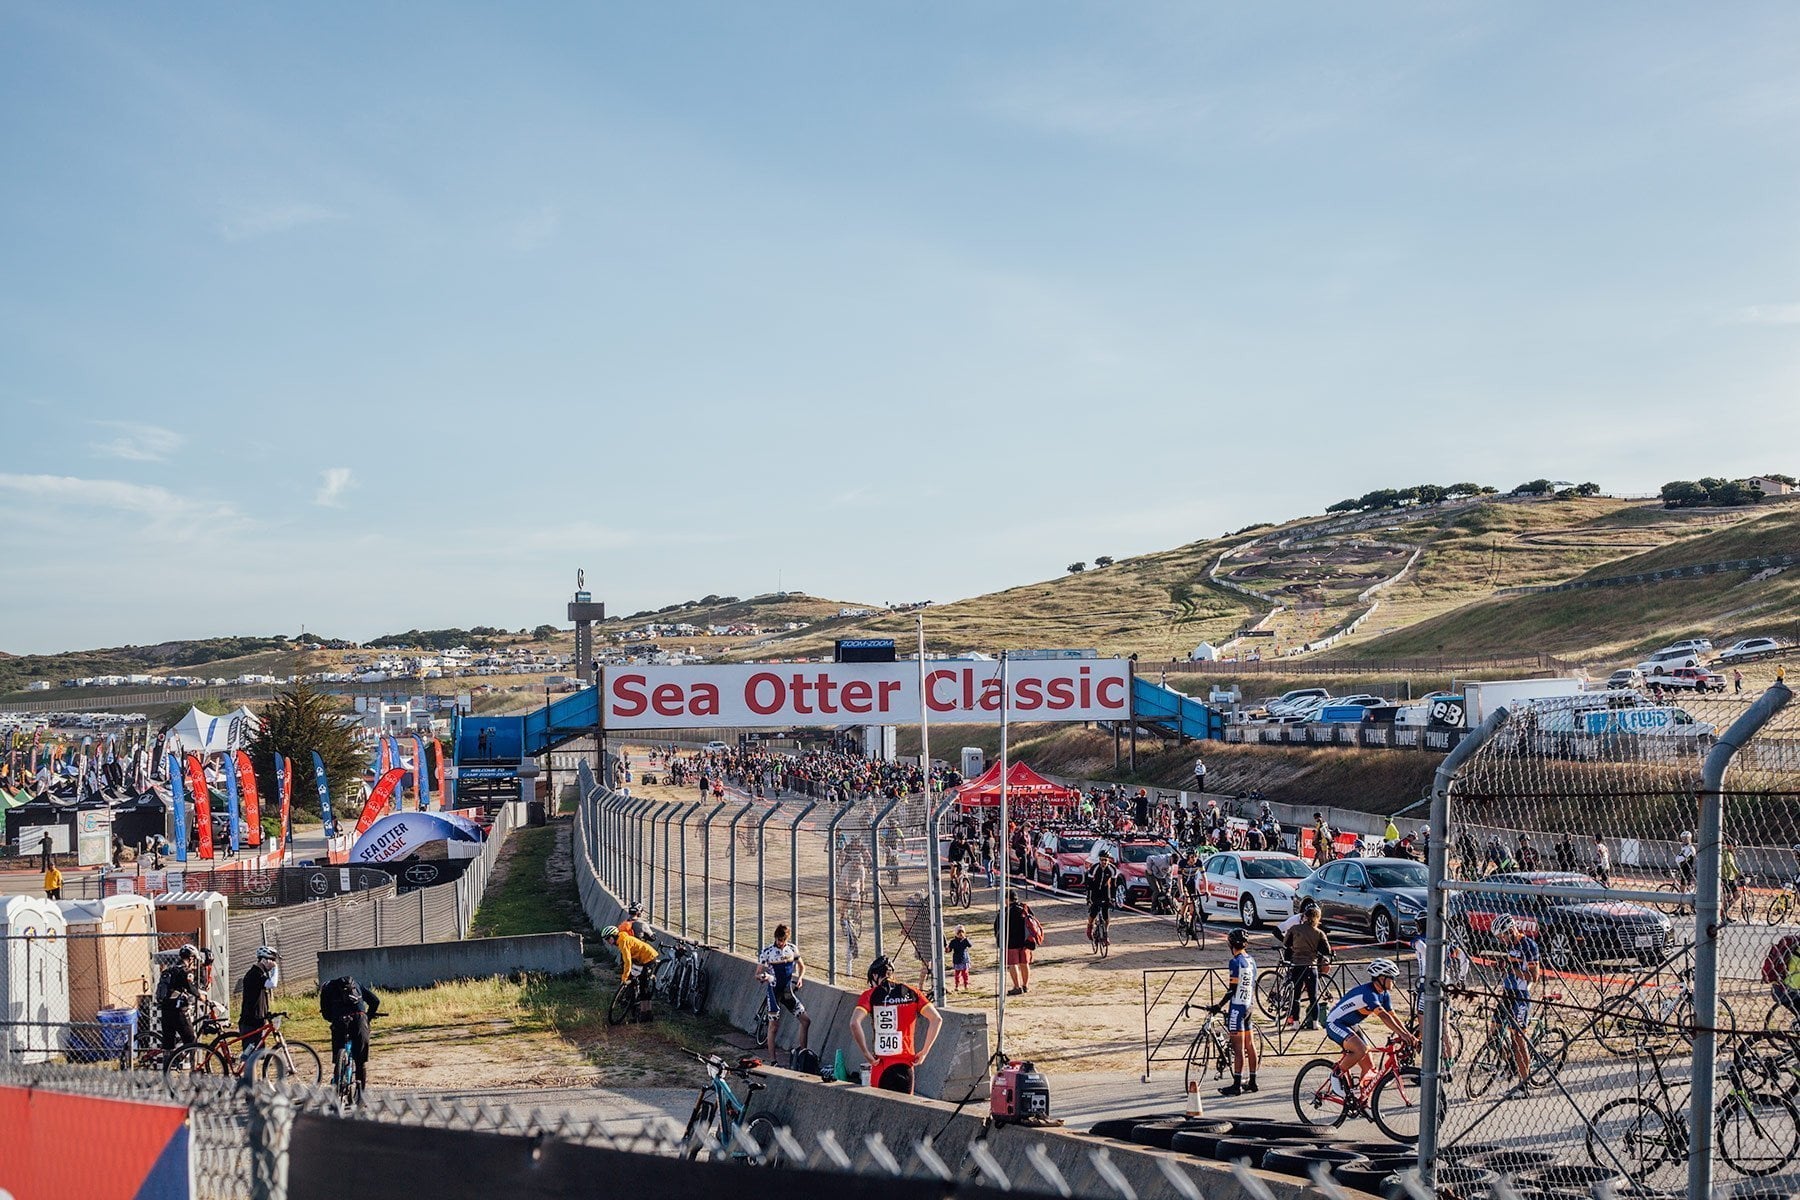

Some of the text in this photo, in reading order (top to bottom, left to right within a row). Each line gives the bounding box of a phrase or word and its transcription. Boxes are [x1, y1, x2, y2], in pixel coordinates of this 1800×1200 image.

[612, 666, 1124, 717] Sea Otter Classic
[1365, 728, 1387, 744] THULE
[1395, 730, 1417, 745] THULE
[1426, 731, 1449, 748] THULE
[360, 822, 409, 862] SEA OTTER
[374, 838, 407, 862] CLASSIC
[242, 896, 277, 905] SUBARU
[879, 1010, 893, 1029] 546
[879, 1036, 898, 1049] 546
